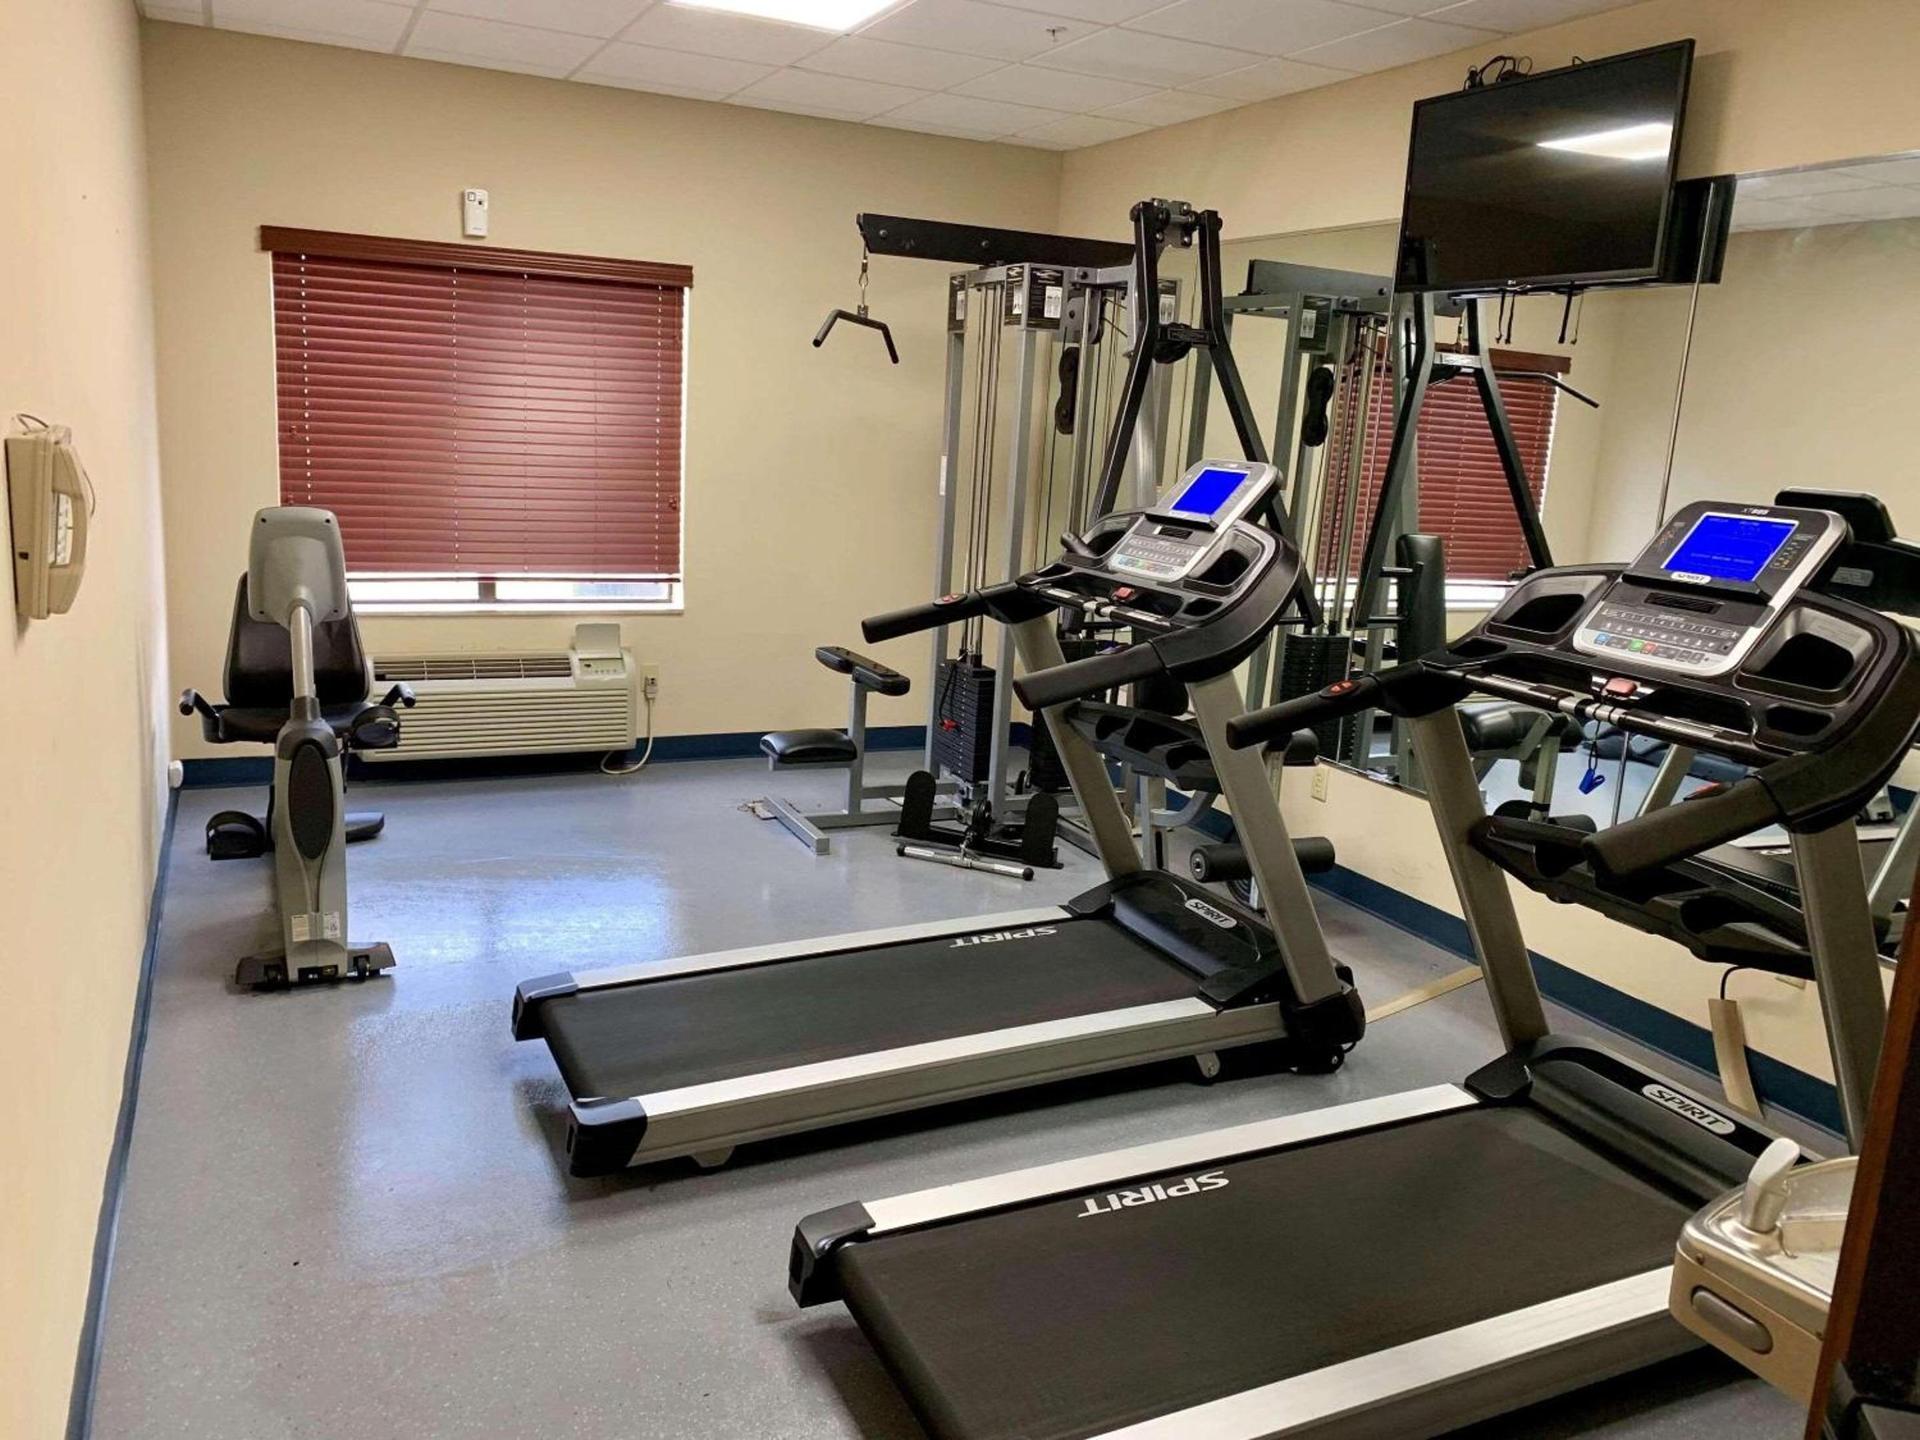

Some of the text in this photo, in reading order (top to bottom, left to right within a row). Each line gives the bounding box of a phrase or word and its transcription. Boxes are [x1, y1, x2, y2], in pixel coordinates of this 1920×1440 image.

[1189, 902, 1232, 923] SPIRIT
[949, 926, 1057, 948] SPIRIT
[1650, 1090, 1726, 1126] SPIRIT
[1077, 1171, 1230, 1218] SPIRIT
